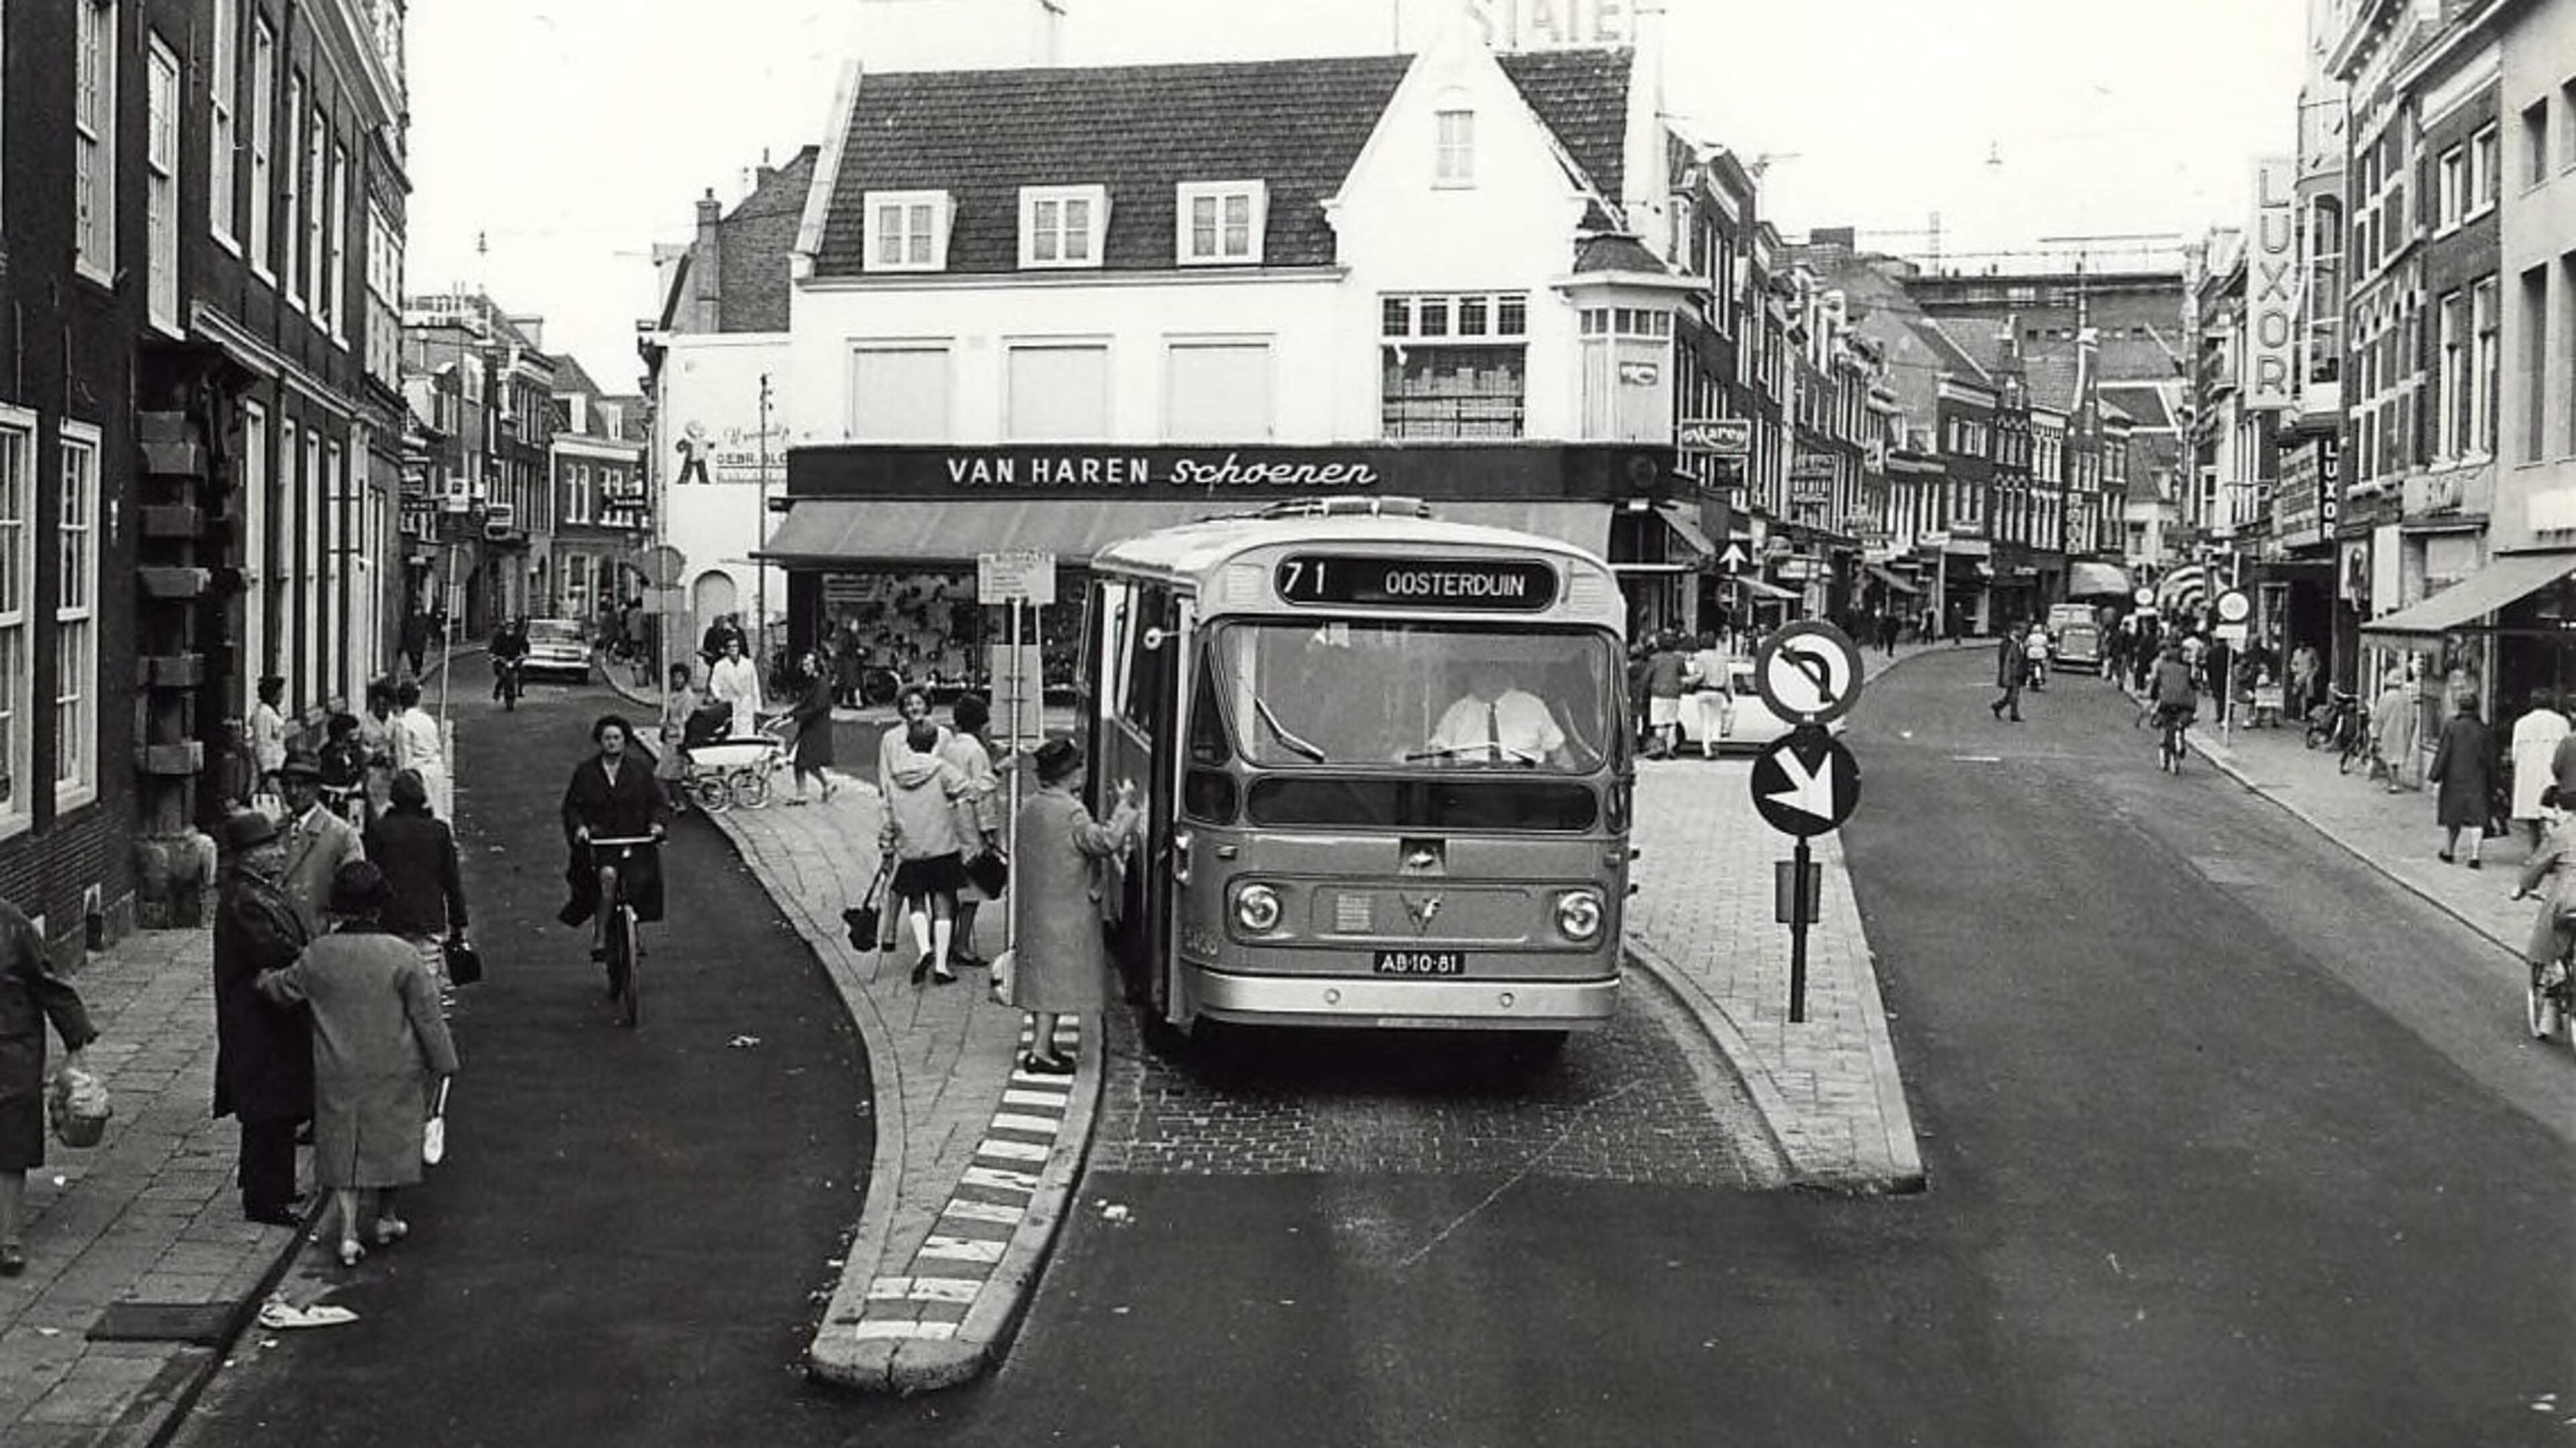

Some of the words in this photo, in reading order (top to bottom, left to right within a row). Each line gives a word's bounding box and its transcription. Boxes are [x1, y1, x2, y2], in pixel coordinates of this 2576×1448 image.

[2256, 170, 2292, 395] LUXOR
[947, 458, 1014, 483] VAN
[1032, 458, 1149, 483] HAREN
[1171, 452, 1377, 486] Schoenen
[2324, 439, 2338, 539] LUXOR
[1385, 572, 1525, 596] OOSTERDUIN
